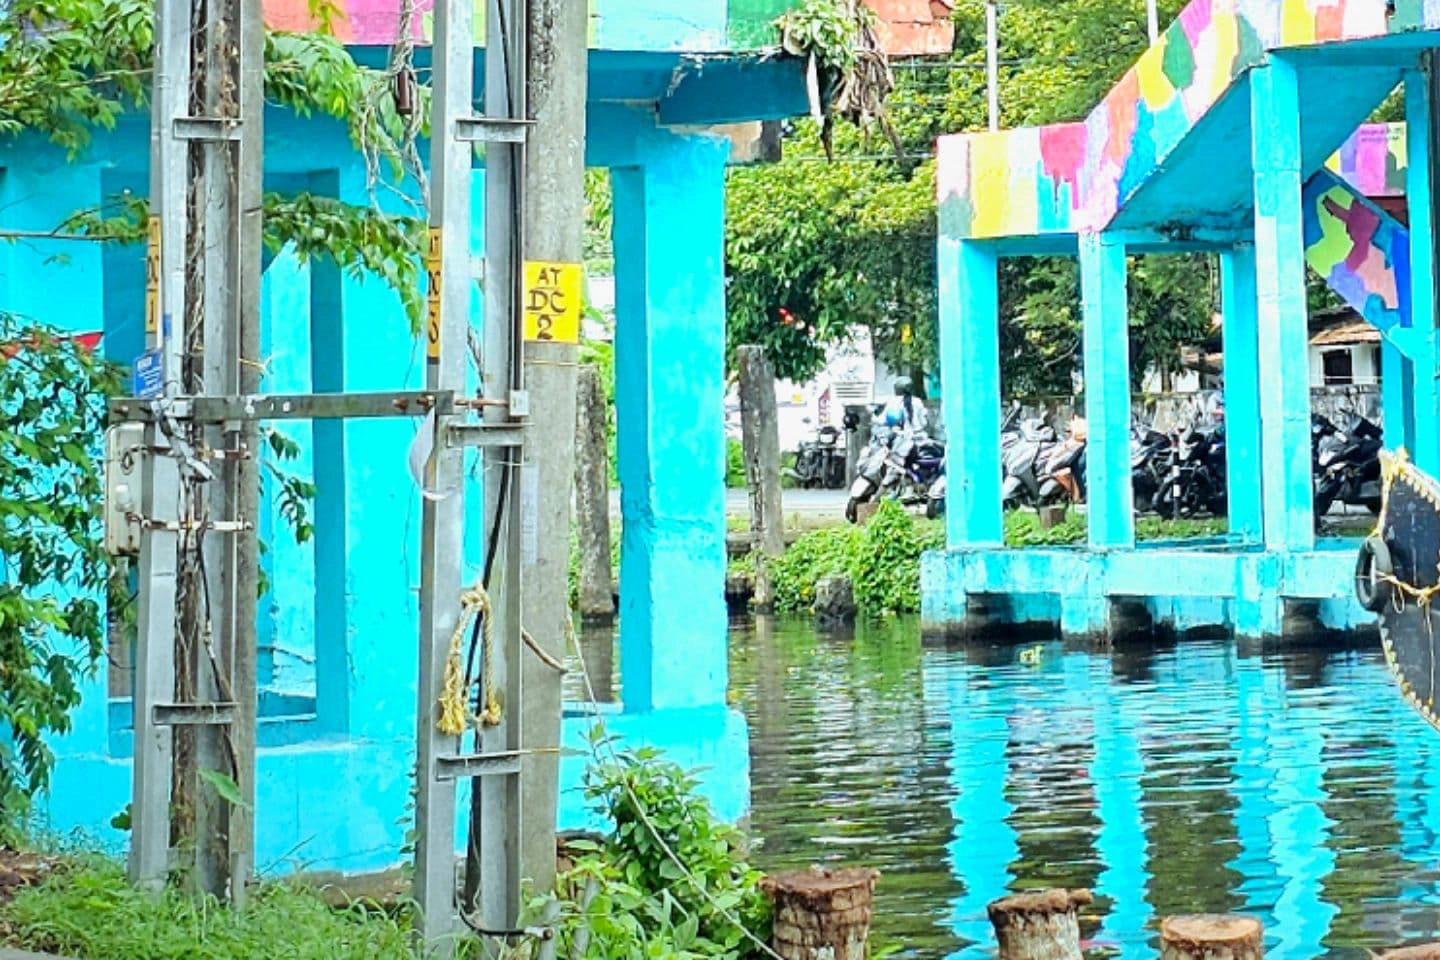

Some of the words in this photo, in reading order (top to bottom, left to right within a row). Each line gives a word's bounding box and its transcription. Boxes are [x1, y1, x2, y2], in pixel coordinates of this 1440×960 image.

[537, 268, 562, 285] AT
[526, 289, 567, 313] DC
[537, 313, 553, 340] 2
